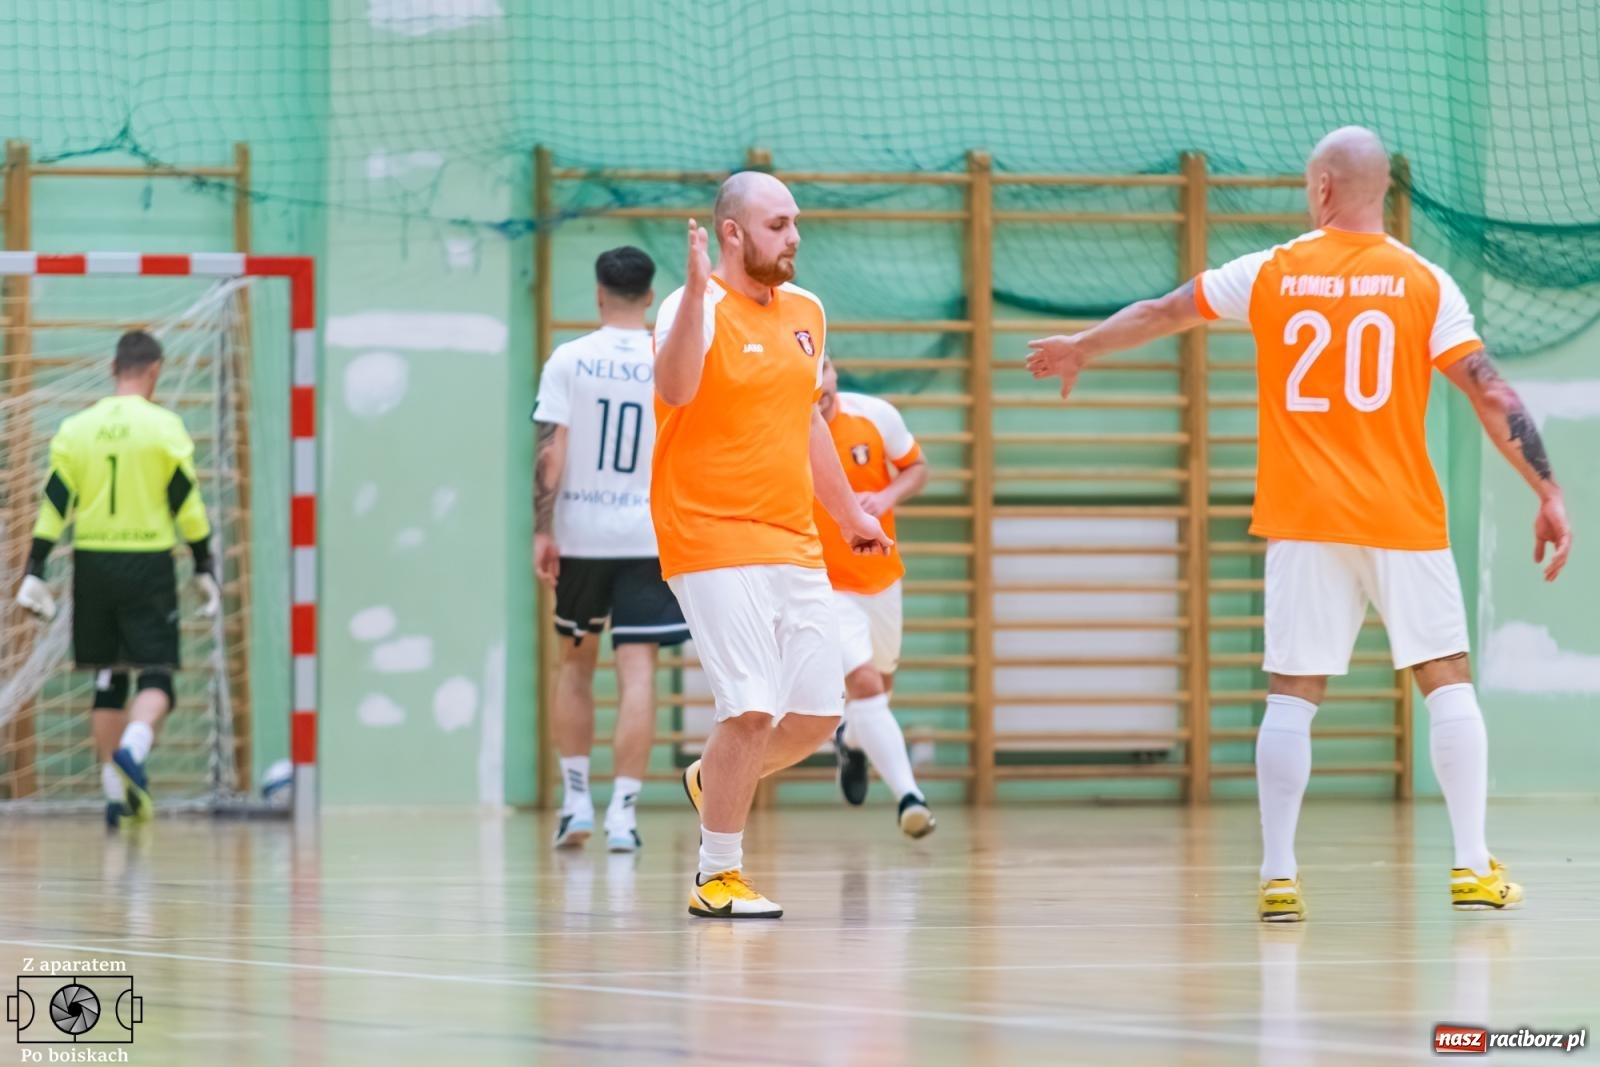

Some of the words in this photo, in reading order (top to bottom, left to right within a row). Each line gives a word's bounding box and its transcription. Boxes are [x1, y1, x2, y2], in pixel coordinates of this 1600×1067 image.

[1349, 274, 1406, 298] KOBYLA
[1283, 309, 1396, 413] 20
[597, 398, 643, 474] 10
[106, 454, 118, 516] 1
